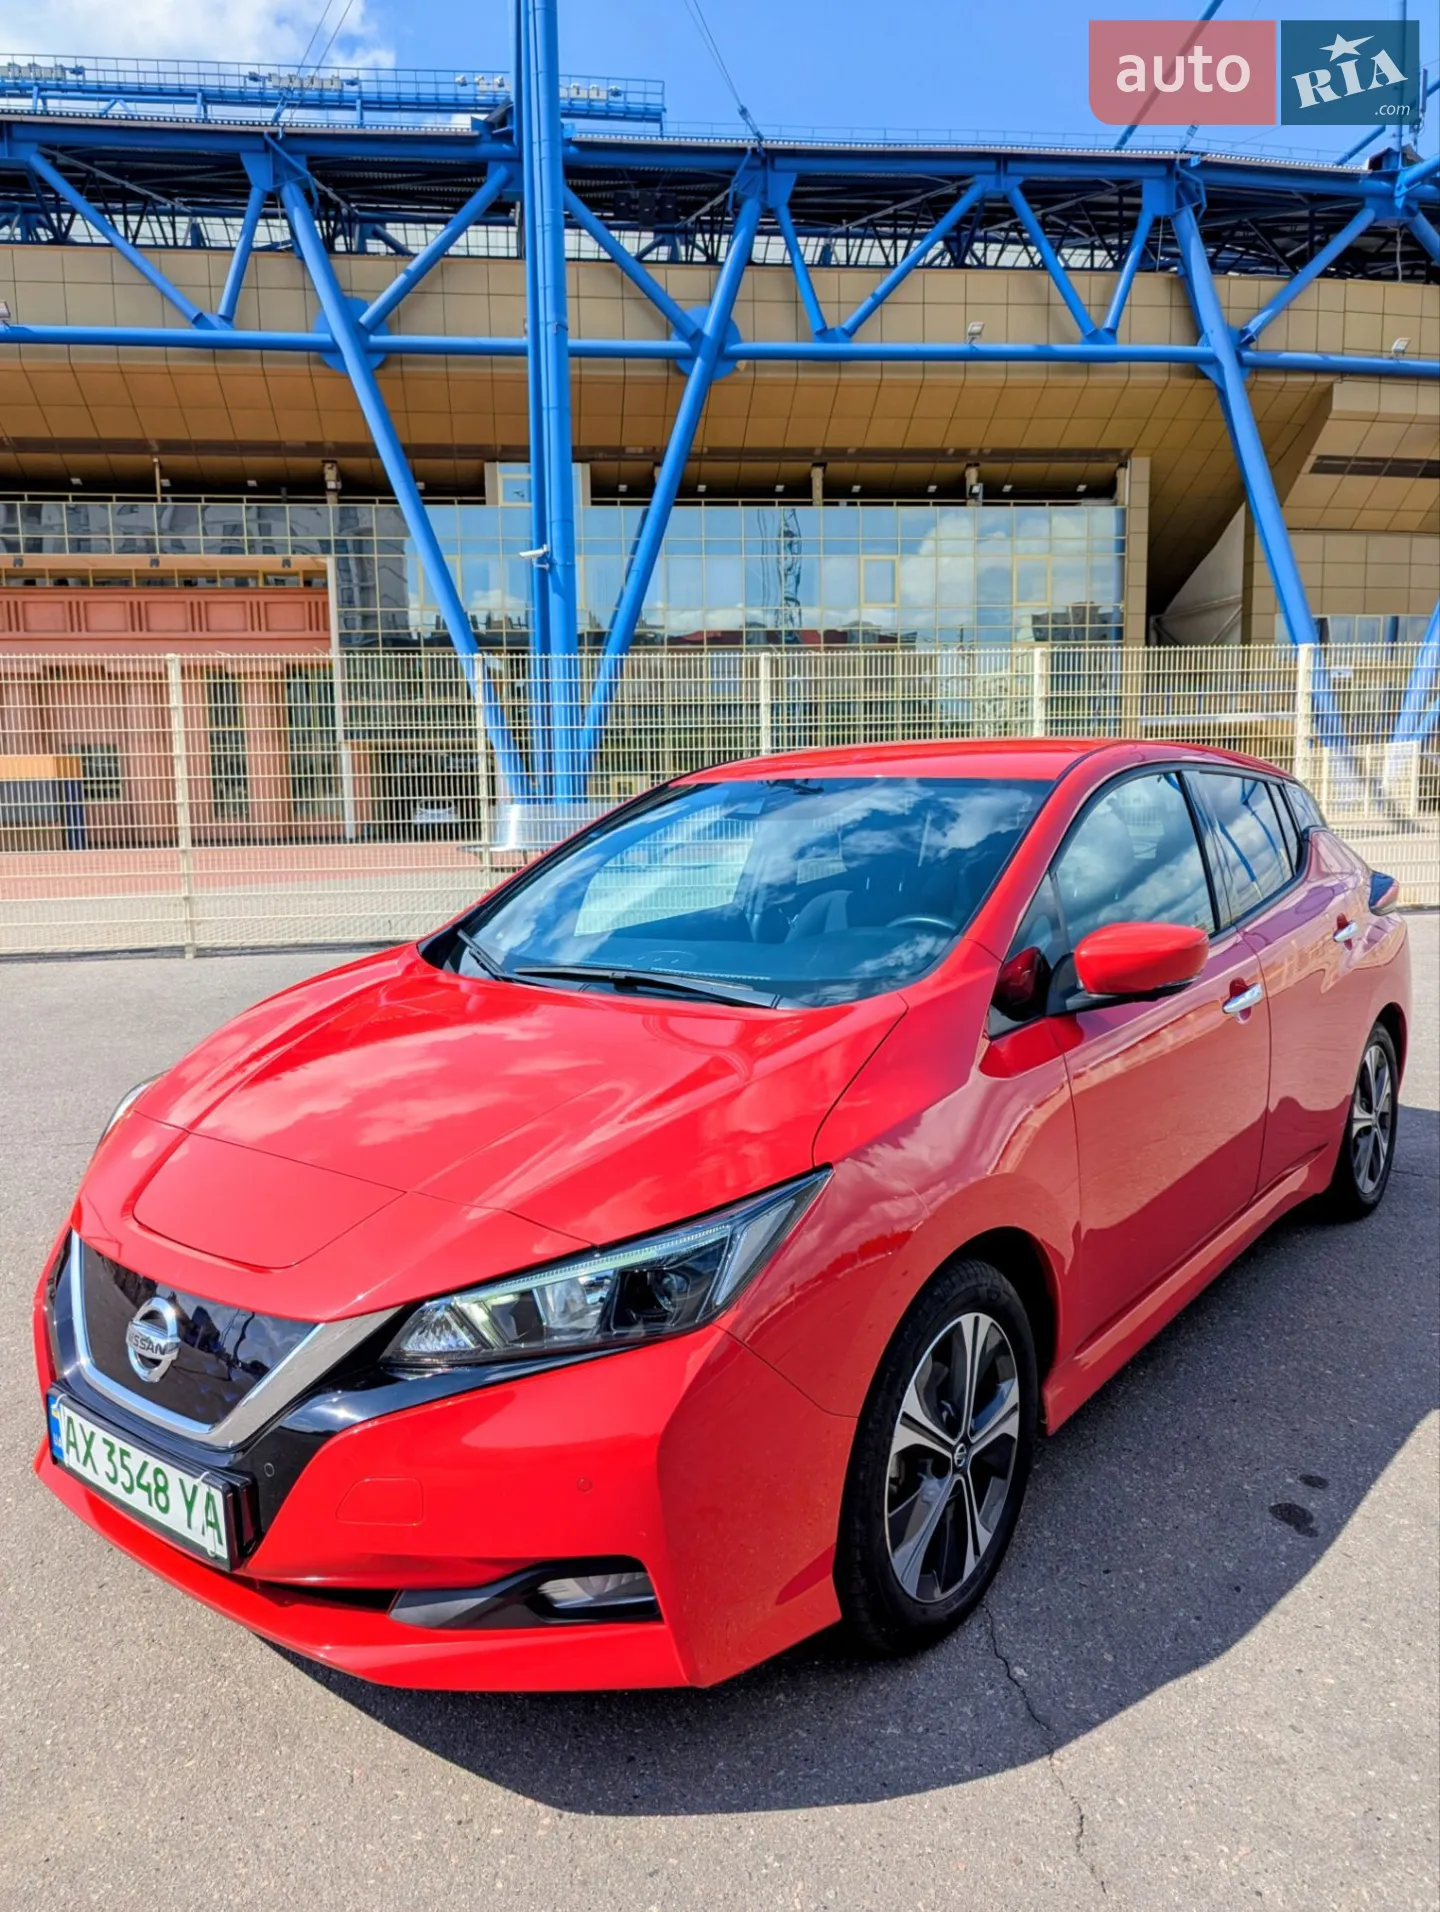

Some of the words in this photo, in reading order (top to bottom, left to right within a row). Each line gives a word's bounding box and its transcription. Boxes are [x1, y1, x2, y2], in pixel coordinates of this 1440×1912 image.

[65, 1415, 99, 1477] AX
[101, 1437, 170, 1515] 3548
[178, 1477, 223, 1546] YA
